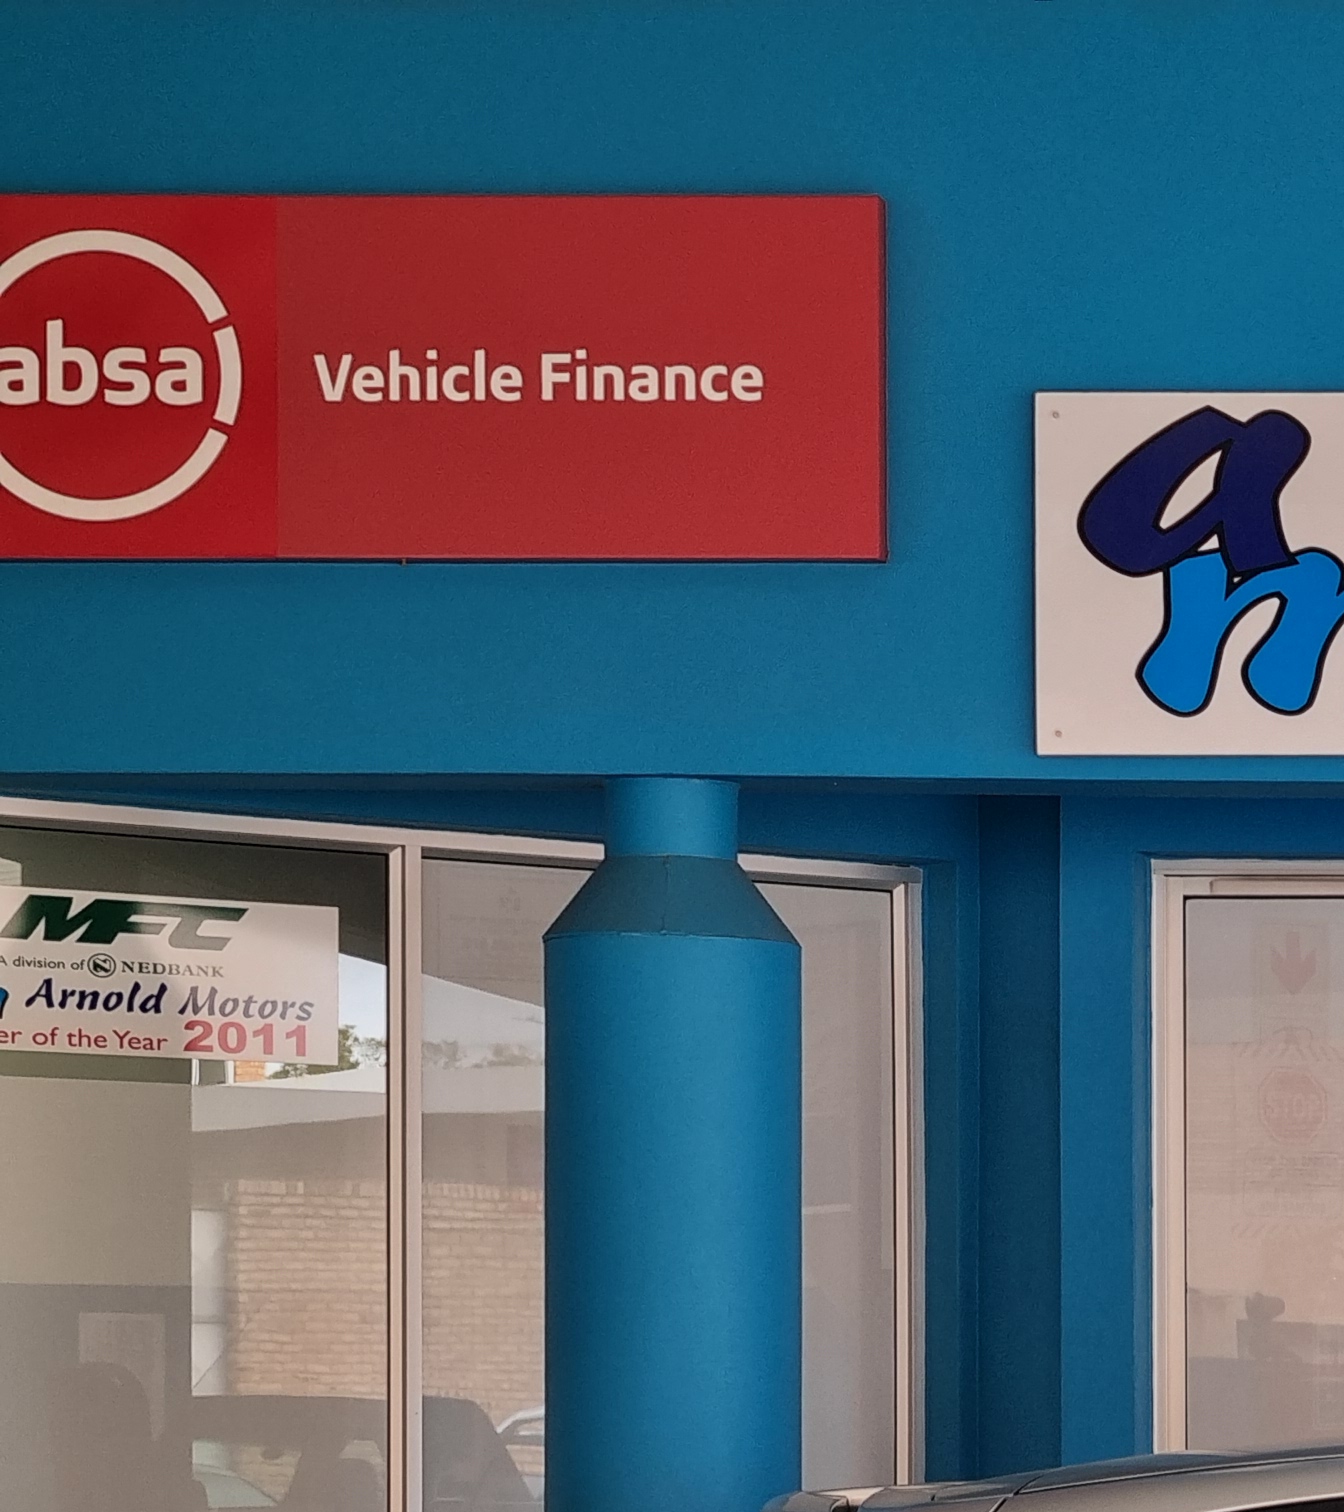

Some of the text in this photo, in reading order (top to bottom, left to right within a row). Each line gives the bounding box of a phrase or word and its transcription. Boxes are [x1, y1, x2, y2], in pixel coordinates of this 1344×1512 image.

[0, 318, 204, 406] absa
[314, 349, 764, 403] Vehicle Finance
[0, 894, 249, 951] MFC
[12, 956, 66, 970] division
[70, 958, 86, 970] of
[121, 961, 224, 978] NEDBANK
[25, 978, 168, 1014] Arnold
[178, 985, 314, 1021] Motors
[32, 1027, 59, 1046] of
[67, 1028, 107, 1048] the
[113, 1030, 168, 1051] Year
[183, 1020, 306, 1057] 2011
